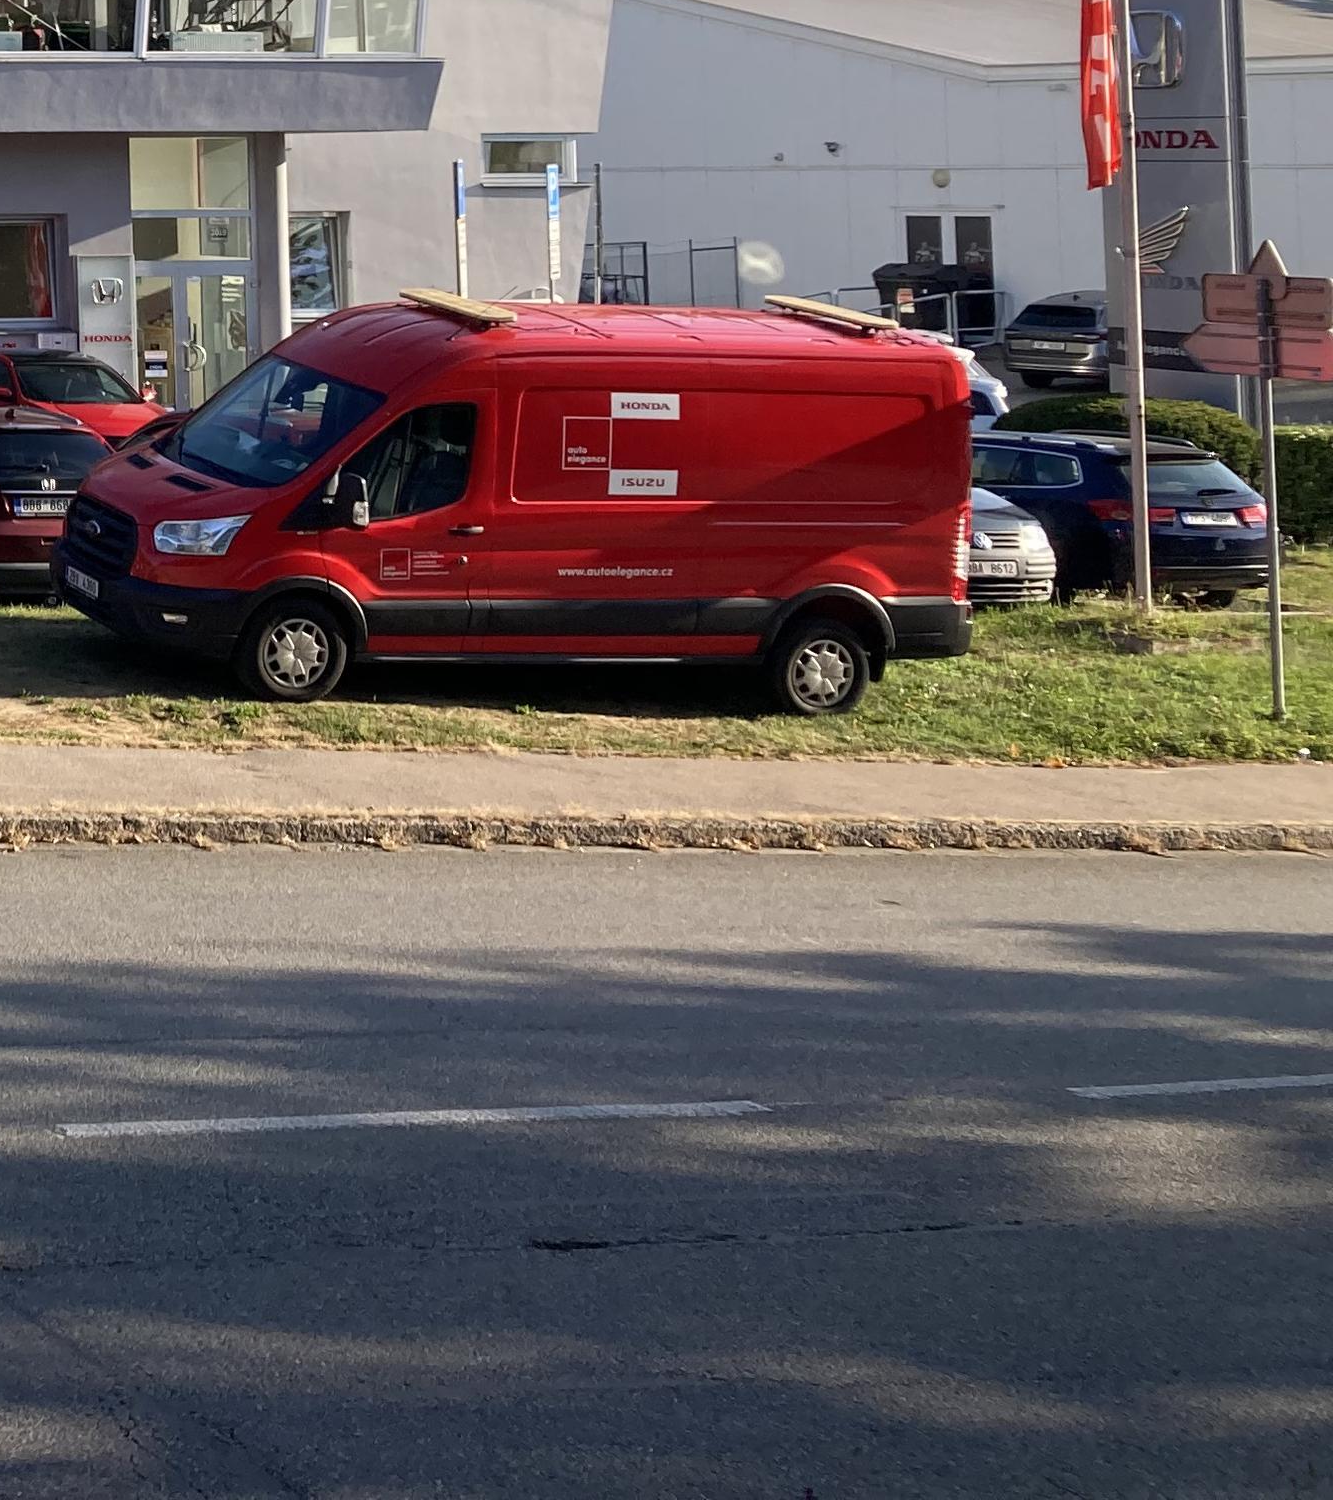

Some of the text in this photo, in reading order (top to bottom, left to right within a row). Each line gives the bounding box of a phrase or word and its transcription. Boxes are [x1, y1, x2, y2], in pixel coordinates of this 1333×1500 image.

[84, 334, 133, 343] HONDA
[620, 402, 671, 411] HONDA
[567, 446, 588, 455] auto
[567, 455, 607, 465] elegance
[621, 478, 666, 488] ISUZU
[557, 566, 674, 579] www.autoelegance.cz
